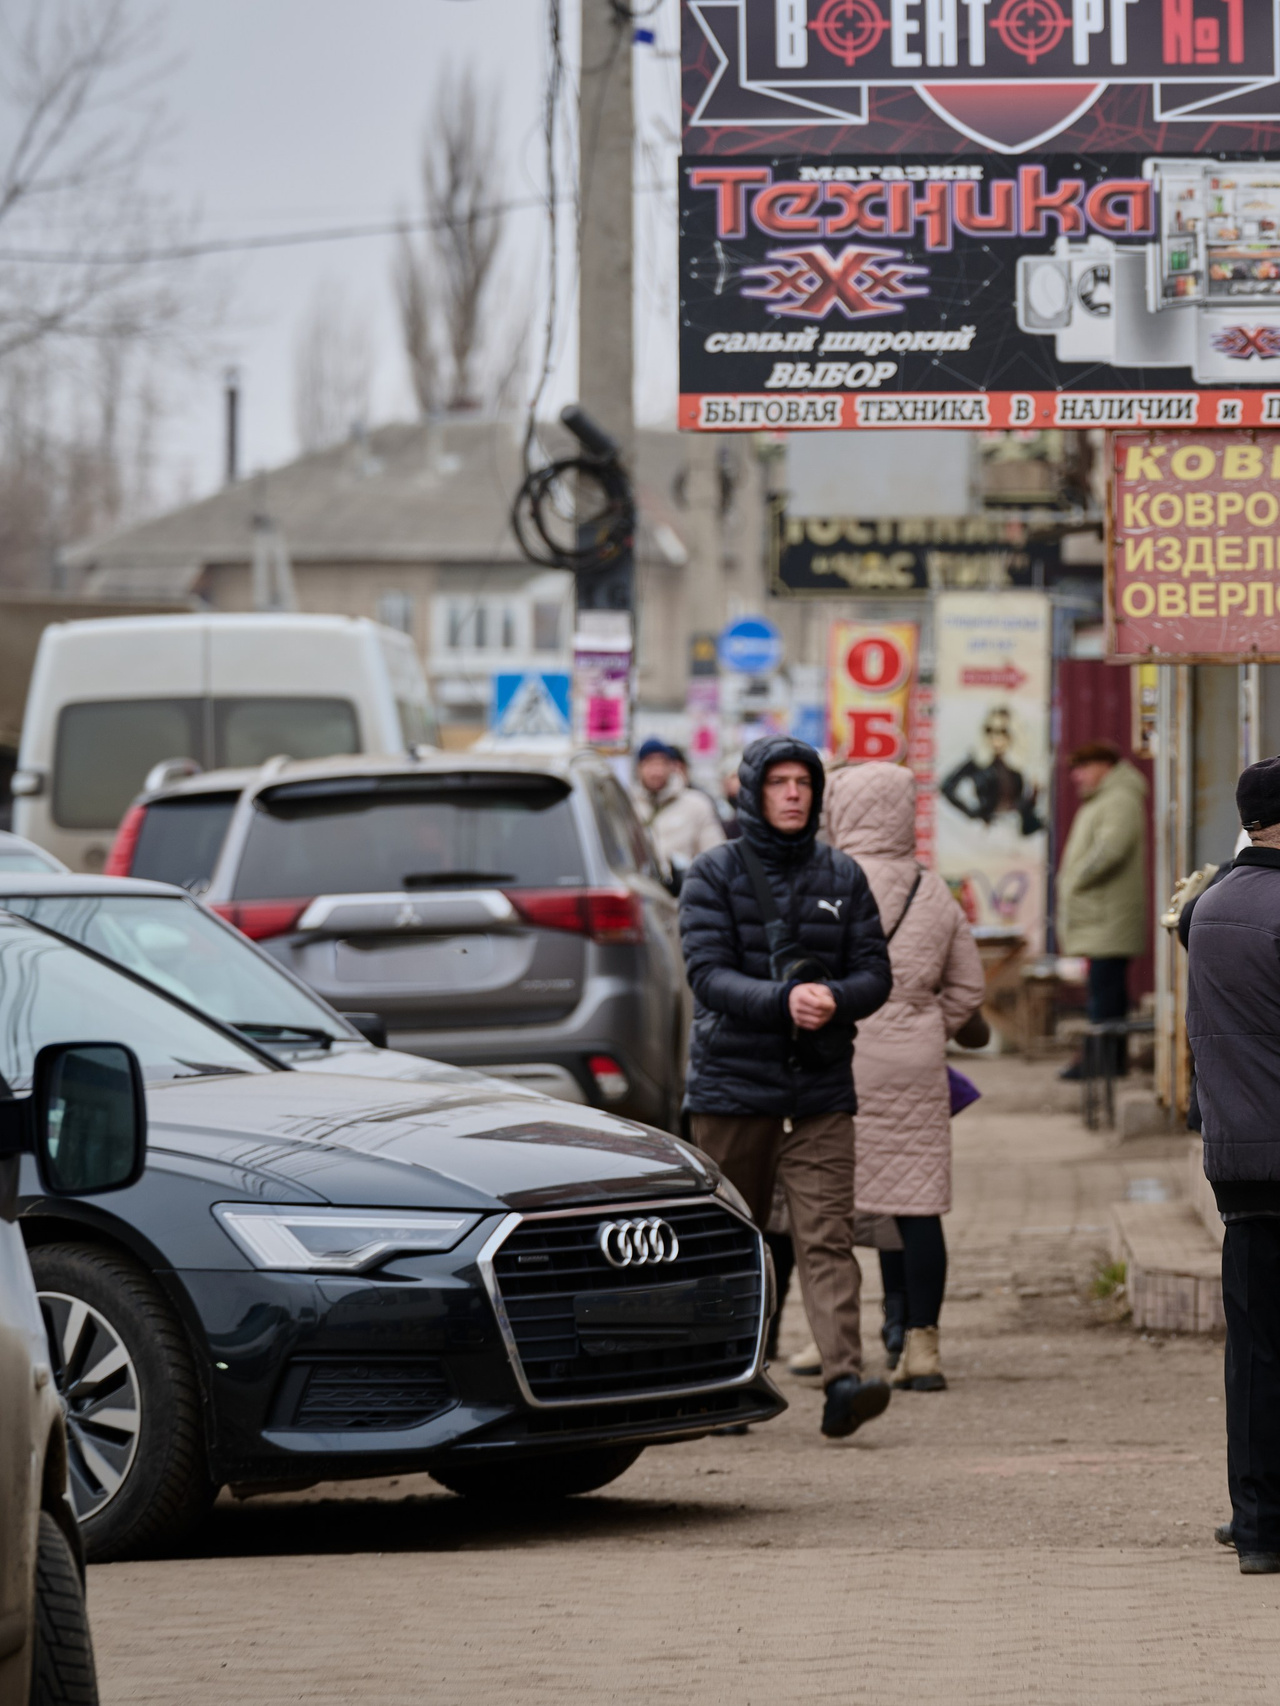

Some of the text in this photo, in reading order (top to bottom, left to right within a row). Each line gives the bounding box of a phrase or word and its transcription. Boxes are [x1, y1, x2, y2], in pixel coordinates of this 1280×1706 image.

[799, 165, 984, 182] магазин
[691, 165, 1155, 251] Техника
[704, 326, 977, 355] самый широкий
[765, 363, 897, 388] ВЫБОР
[704, 400, 838, 423] БЫТОВАЯ
[858, 399, 986, 422] ТЕХНИКА
[1014, 400, 1030, 420] В
[1059, 398, 1195, 420] НАЛИЧИИ
[1220, 403, 1237, 418] и
